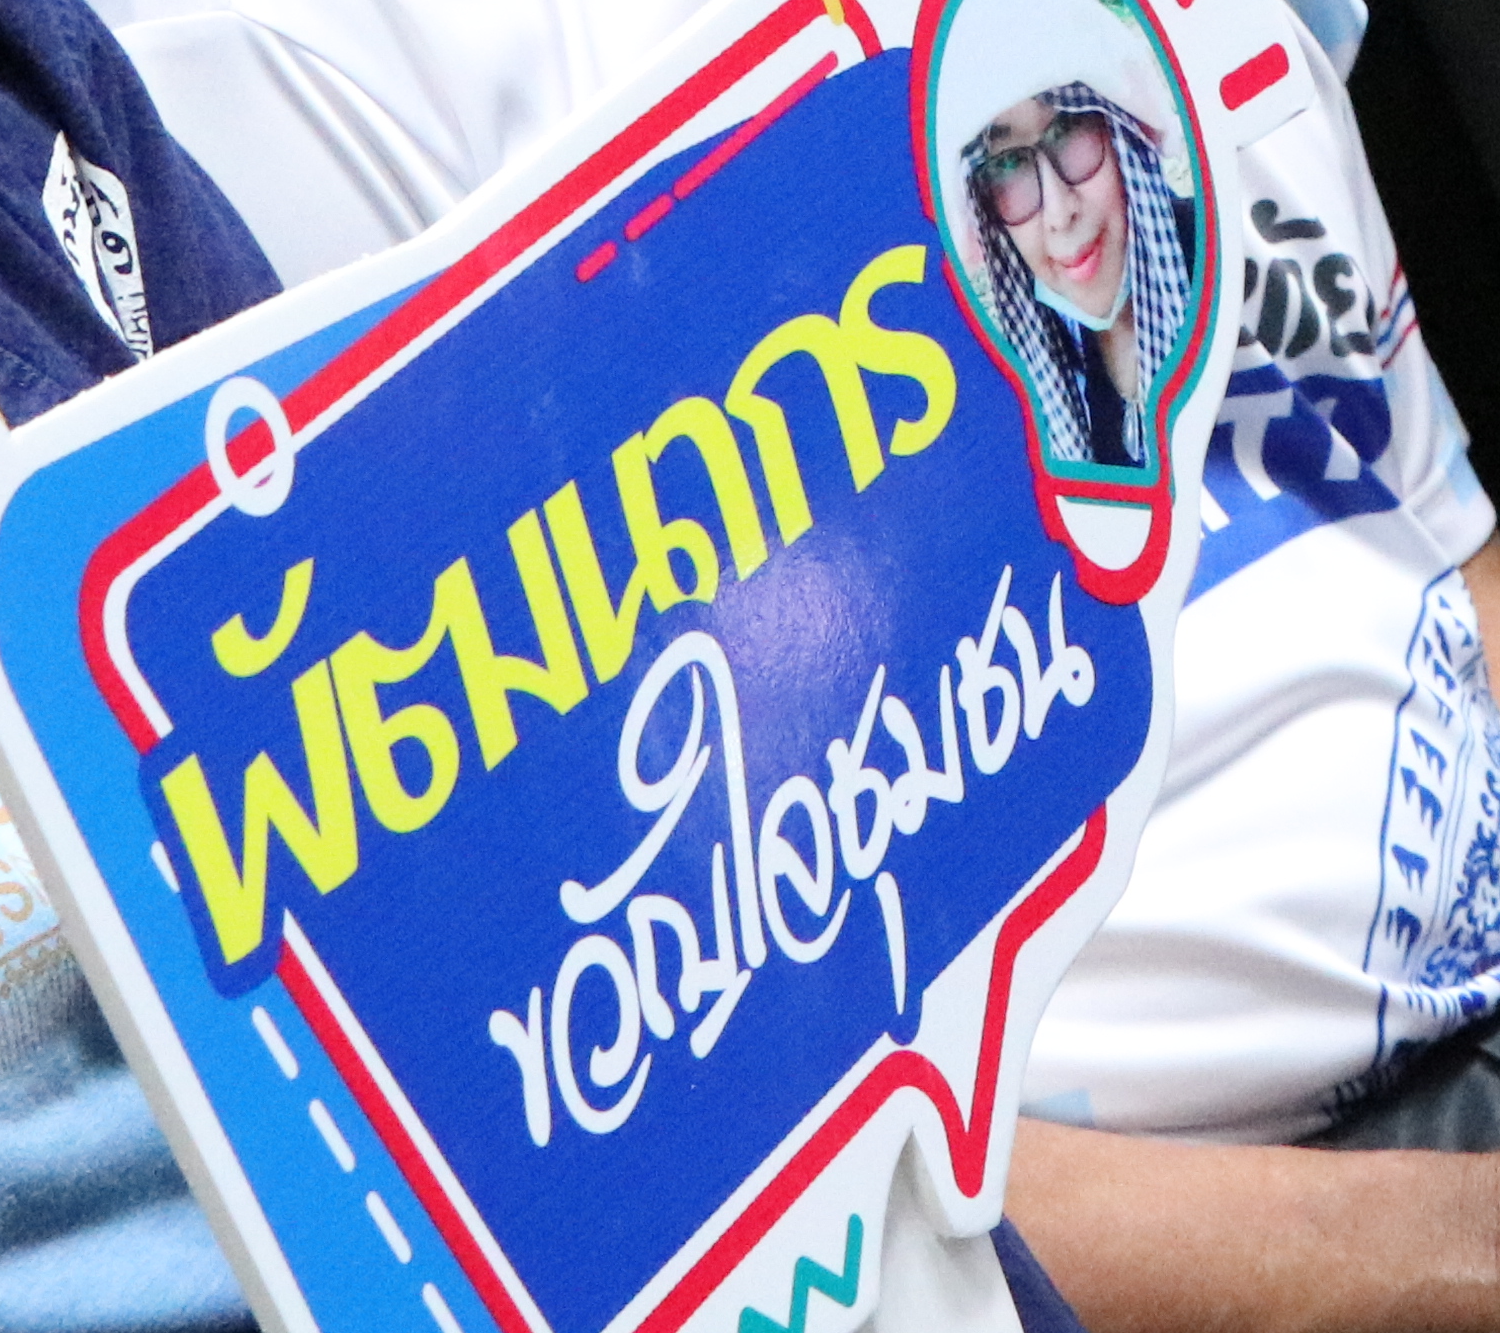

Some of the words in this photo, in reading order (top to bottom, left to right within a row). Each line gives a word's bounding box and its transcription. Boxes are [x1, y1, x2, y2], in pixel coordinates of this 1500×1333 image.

[158, 242, 959, 967] พัฒนากร
[487, 563, 1097, 1149] ขวัญใจชุมชน
